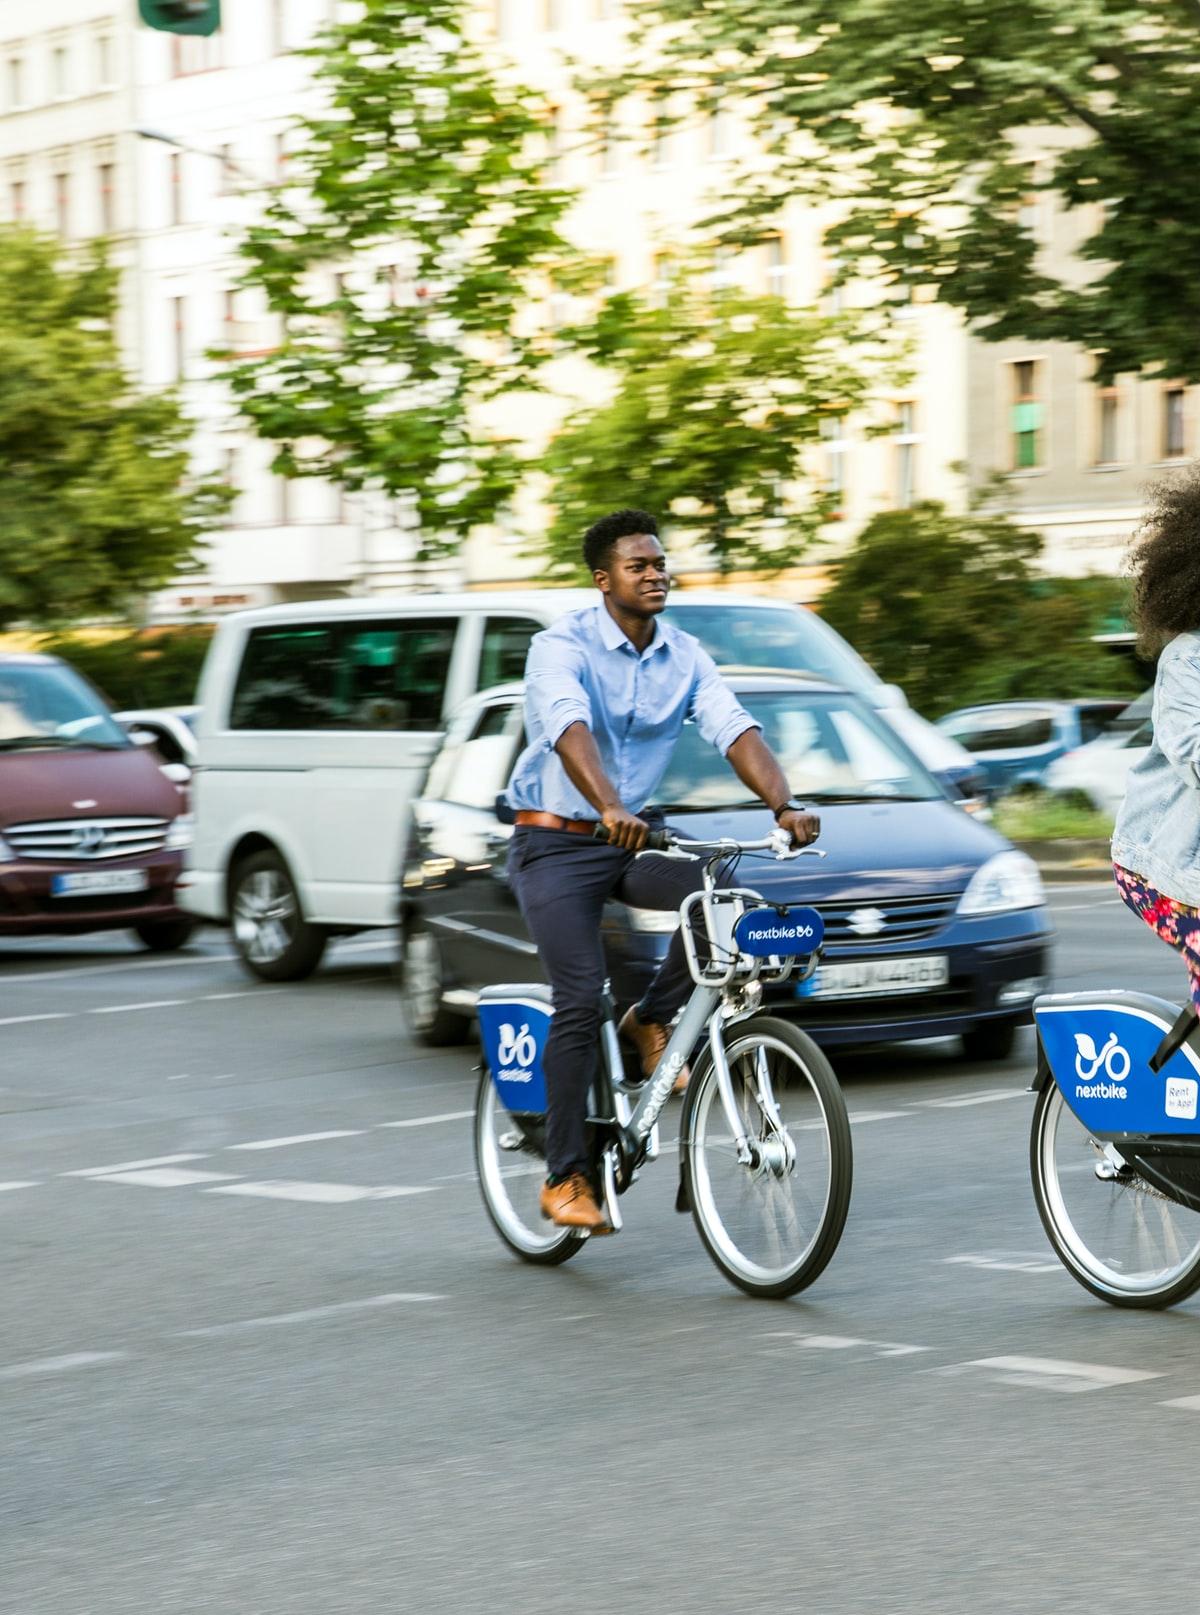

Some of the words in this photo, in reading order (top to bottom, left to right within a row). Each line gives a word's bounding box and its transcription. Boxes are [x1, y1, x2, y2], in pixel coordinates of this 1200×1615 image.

[748, 925, 796, 940] nextbike
[1075, 1082, 1128, 1099] nextbike
[1169, 1087, 1189, 1097] Rent
